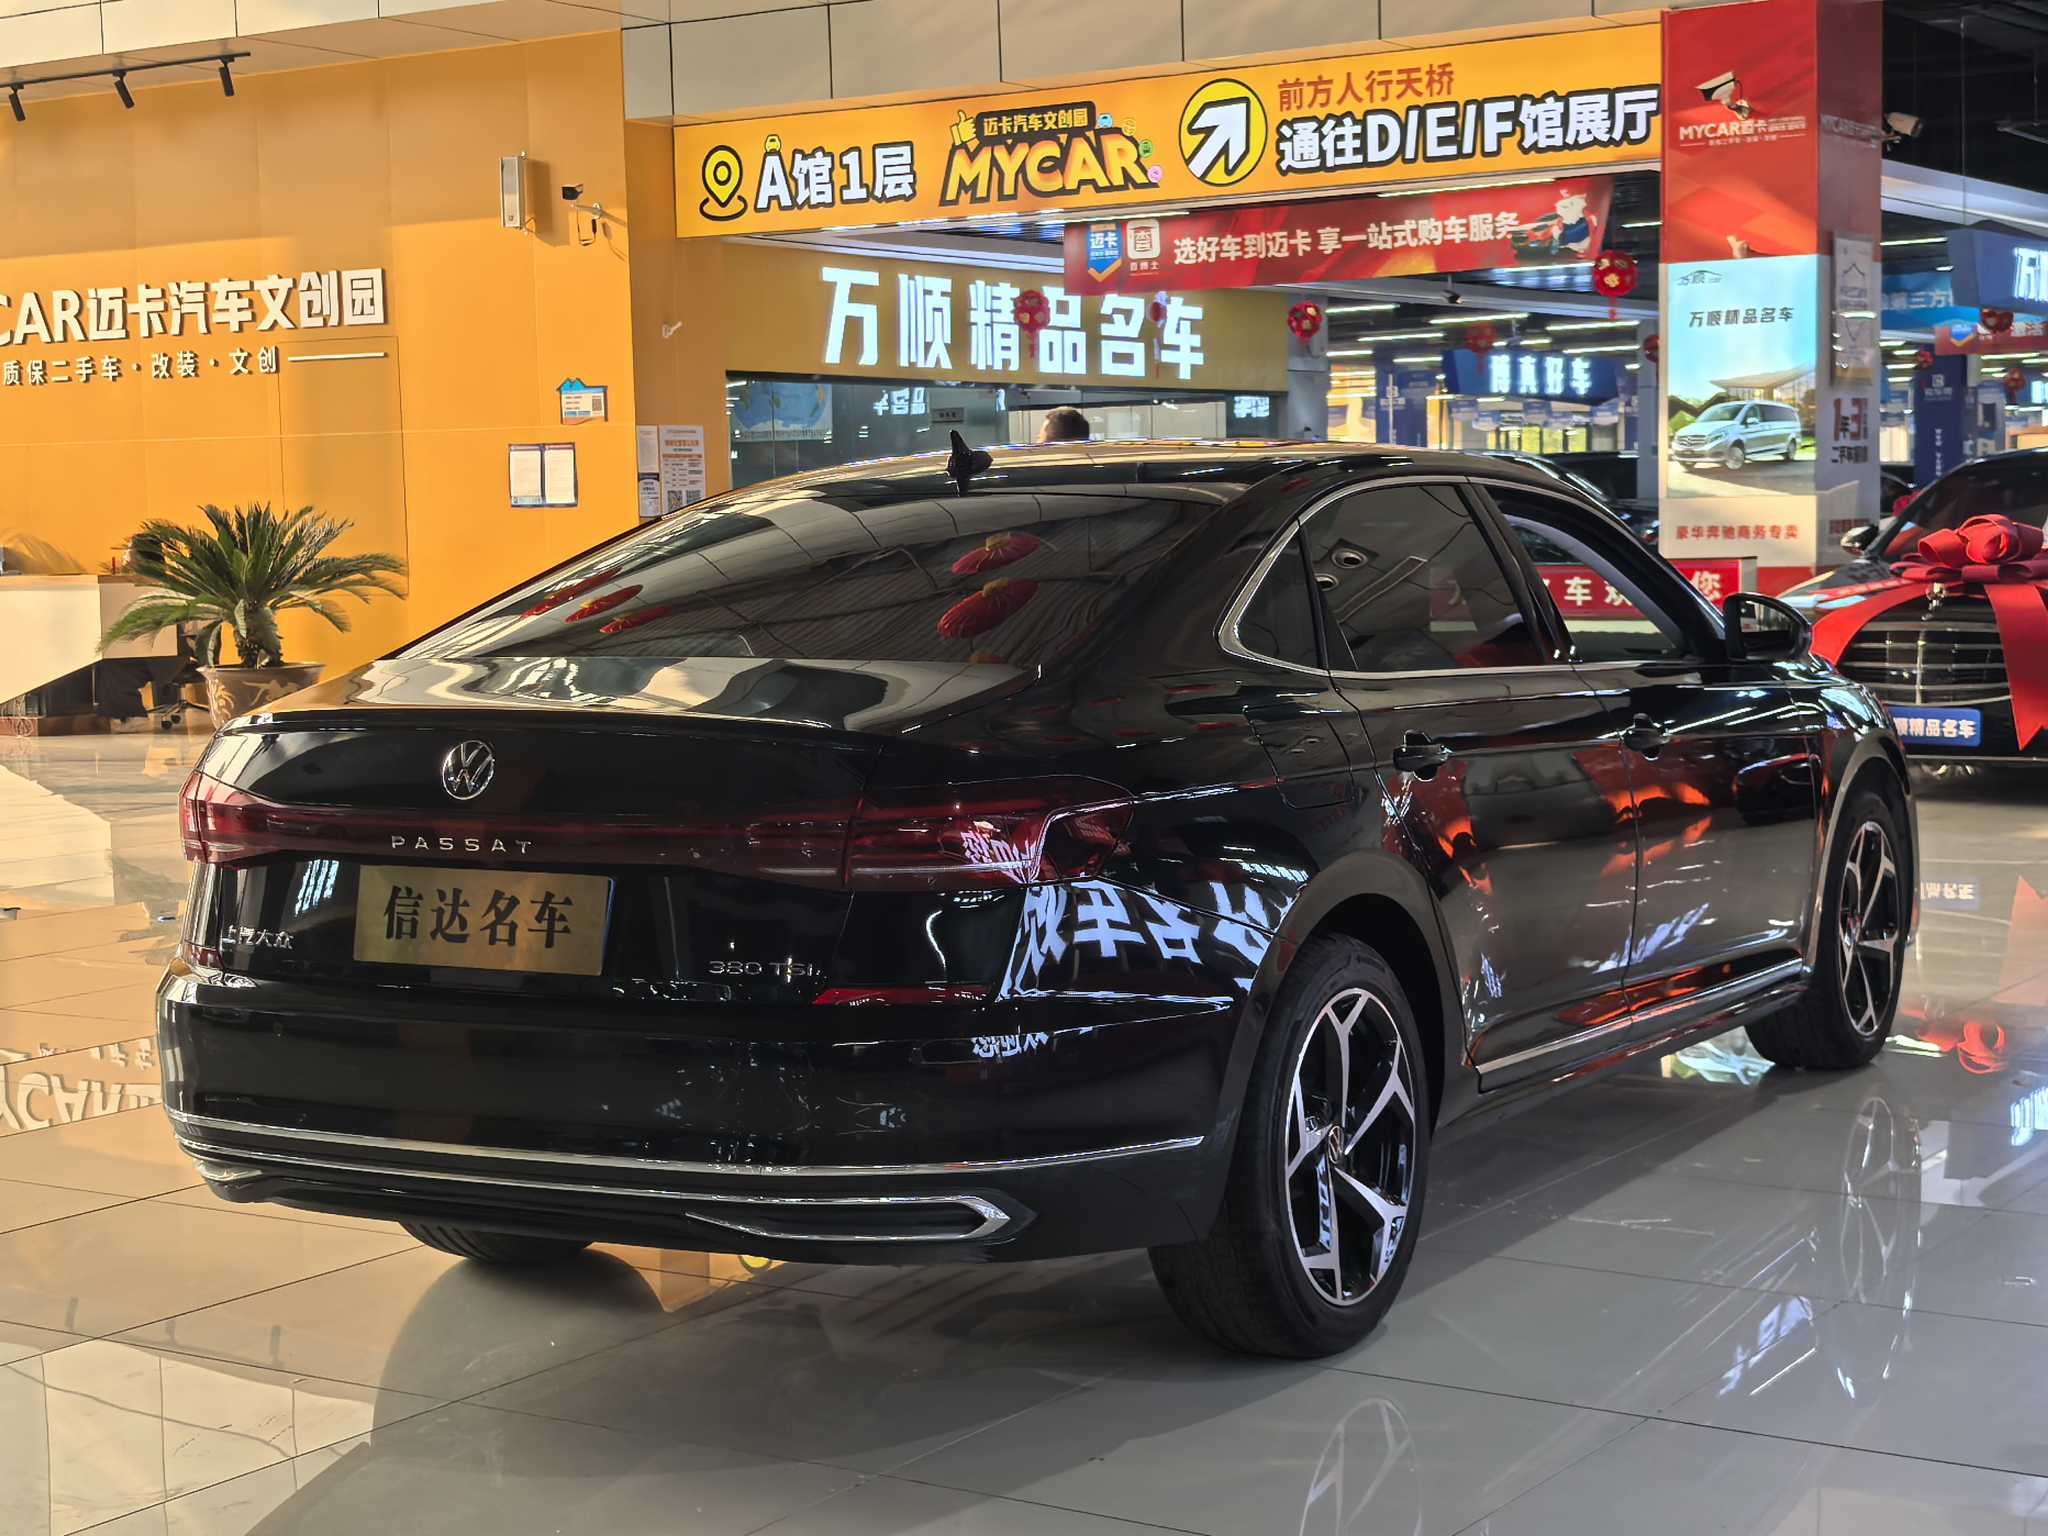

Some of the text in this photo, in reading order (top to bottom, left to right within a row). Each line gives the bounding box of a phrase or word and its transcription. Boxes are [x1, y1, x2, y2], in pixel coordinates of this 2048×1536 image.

[1278, 62, 1455, 112] 前方人行天桥
[983, 108, 1088, 136] 迈卡汽车文创园
[1278, 88, 1660, 172] 通往D/E/F馆展厅
[754, 140, 917, 212] A馆1层
[945, 133, 1153, 202] MYCAR
[1174, 211, 1520, 265] 选好车到迈卡 享一站式购车服务
[821, 266, 1204, 380] 万顺精品名车
[1688, 306, 1795, 328] 万顺精品名车
[391, 834, 533, 856] PASSAT
[383, 883, 575, 949] 信达名车
[709, 960, 763, 975] 380
